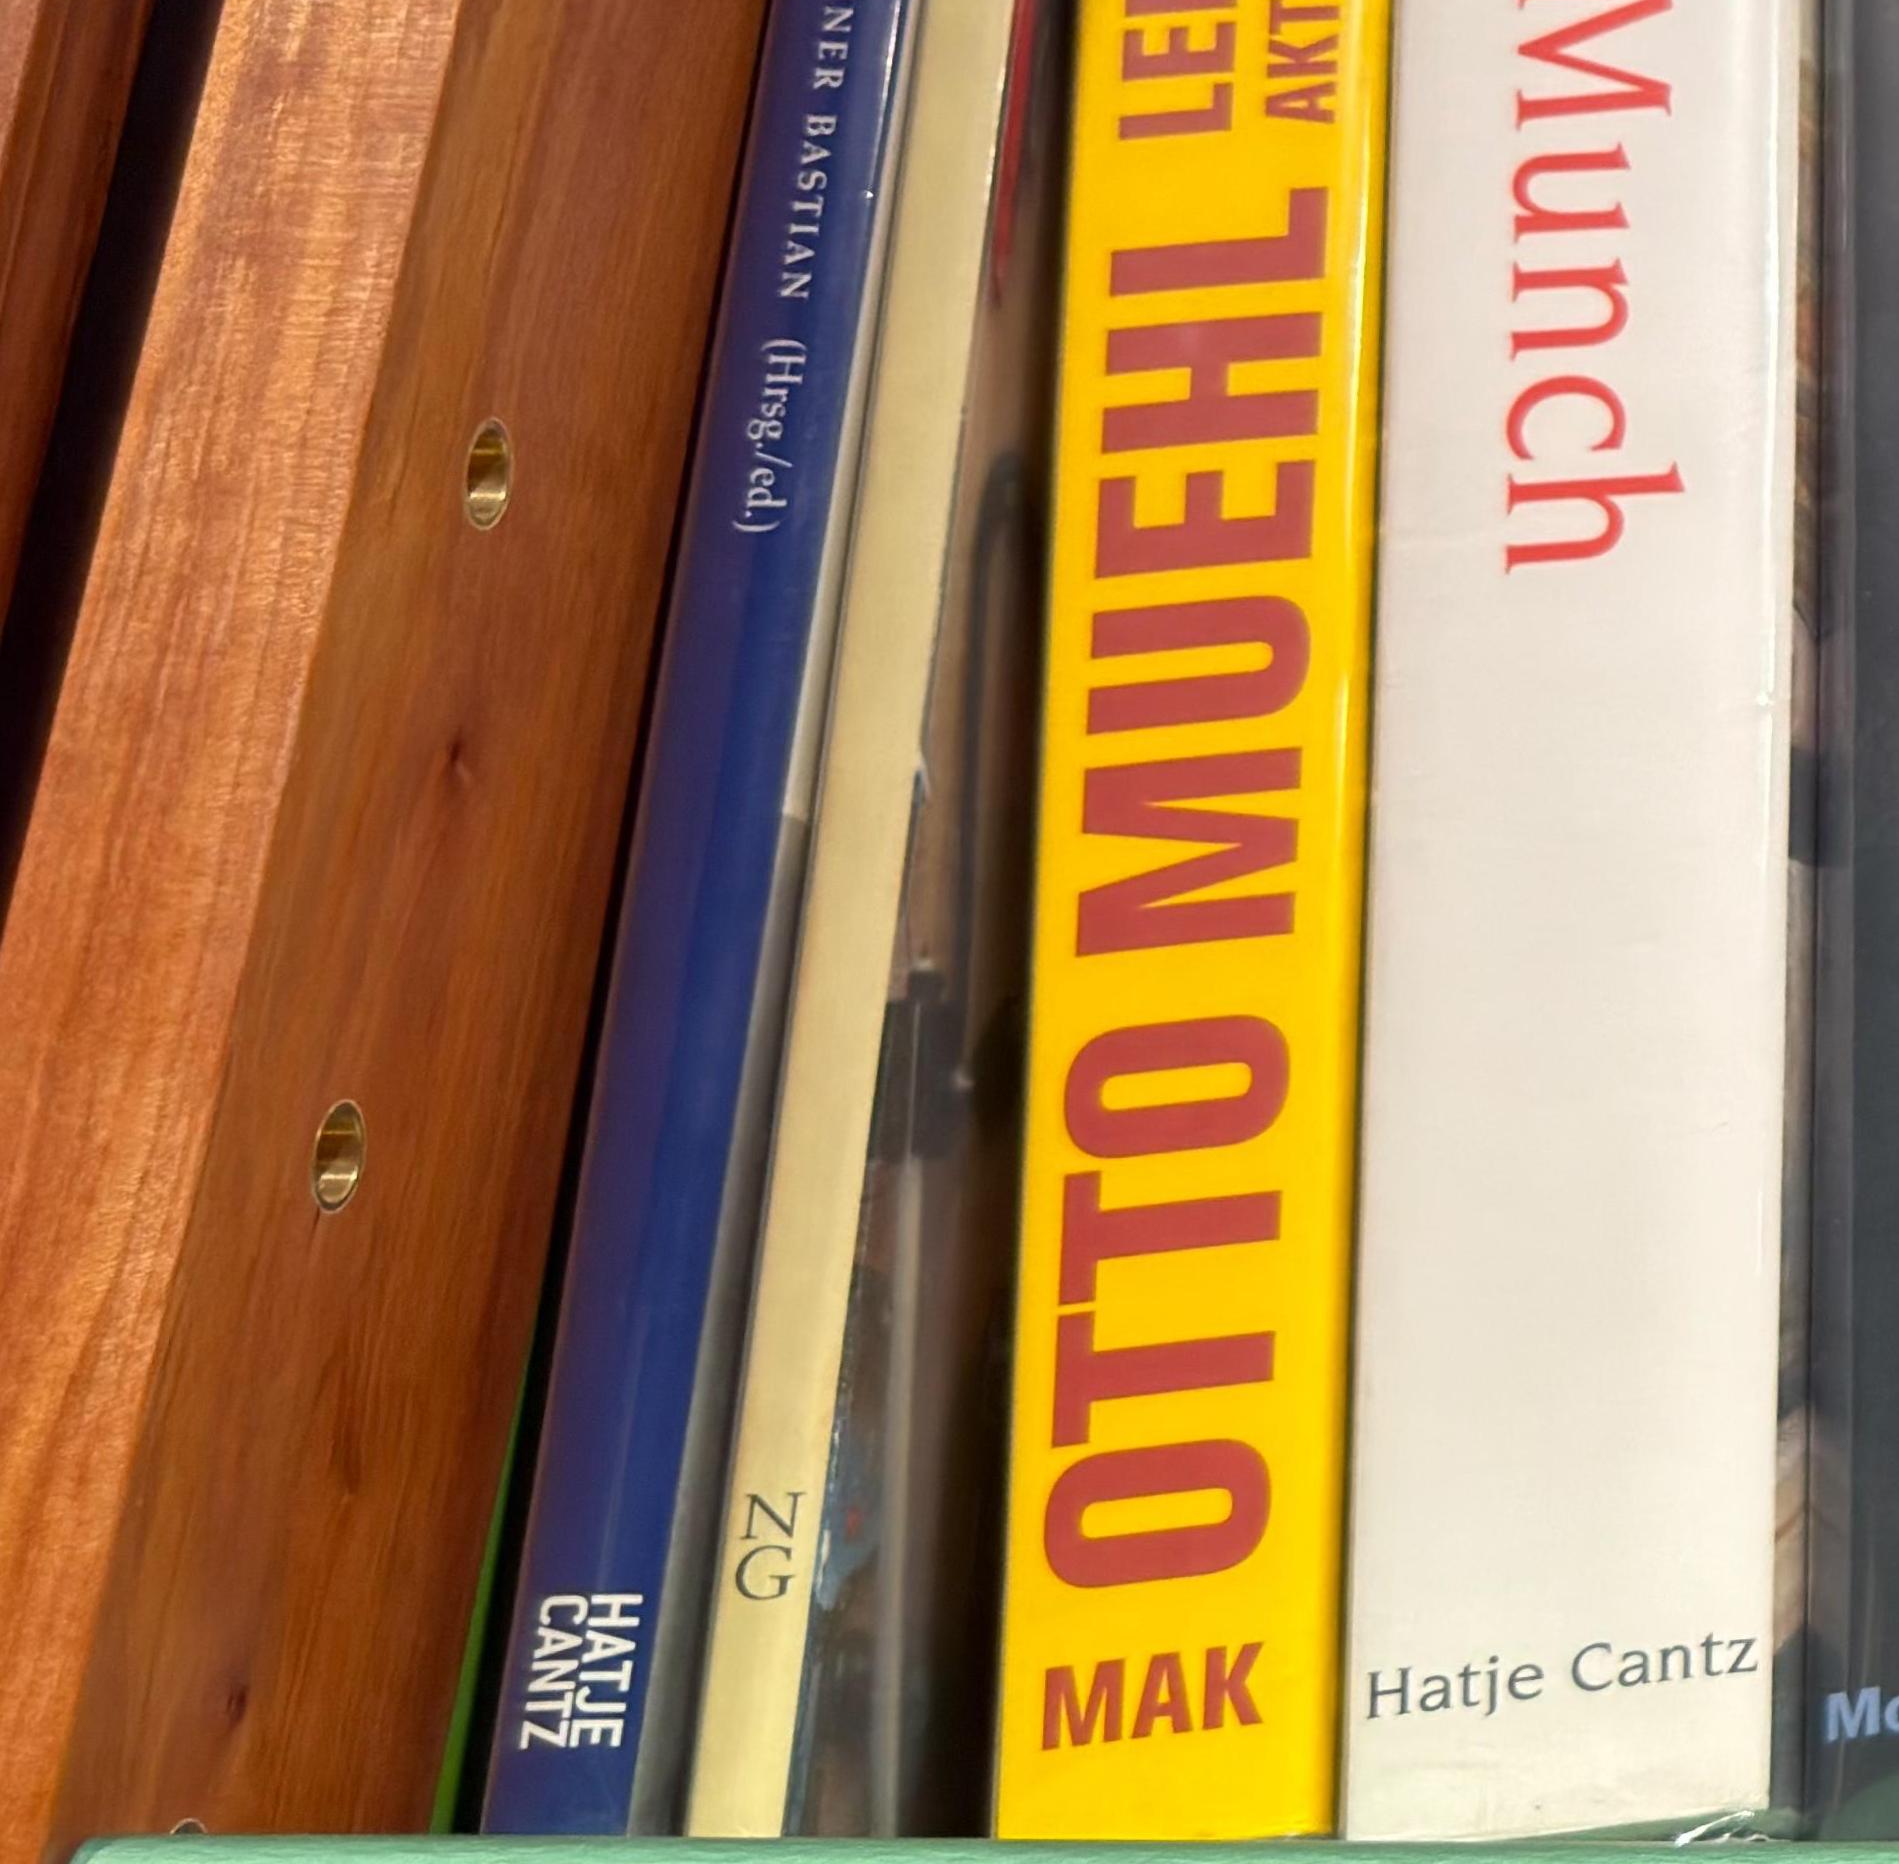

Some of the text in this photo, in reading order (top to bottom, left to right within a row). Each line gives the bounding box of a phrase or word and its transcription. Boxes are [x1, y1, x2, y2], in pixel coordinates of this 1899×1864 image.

[781, 113, 837, 301] BASTIAN
[1045, 186, 1329, 1589] OTTO MUEHL
[519, 1593, 587, 1751] CANTZ
[570, 1593, 644, 1748] HATJE
[1040, 1643, 1262, 1752] MAK
[1366, 1630, 1758, 1721] Hatje Cantz
